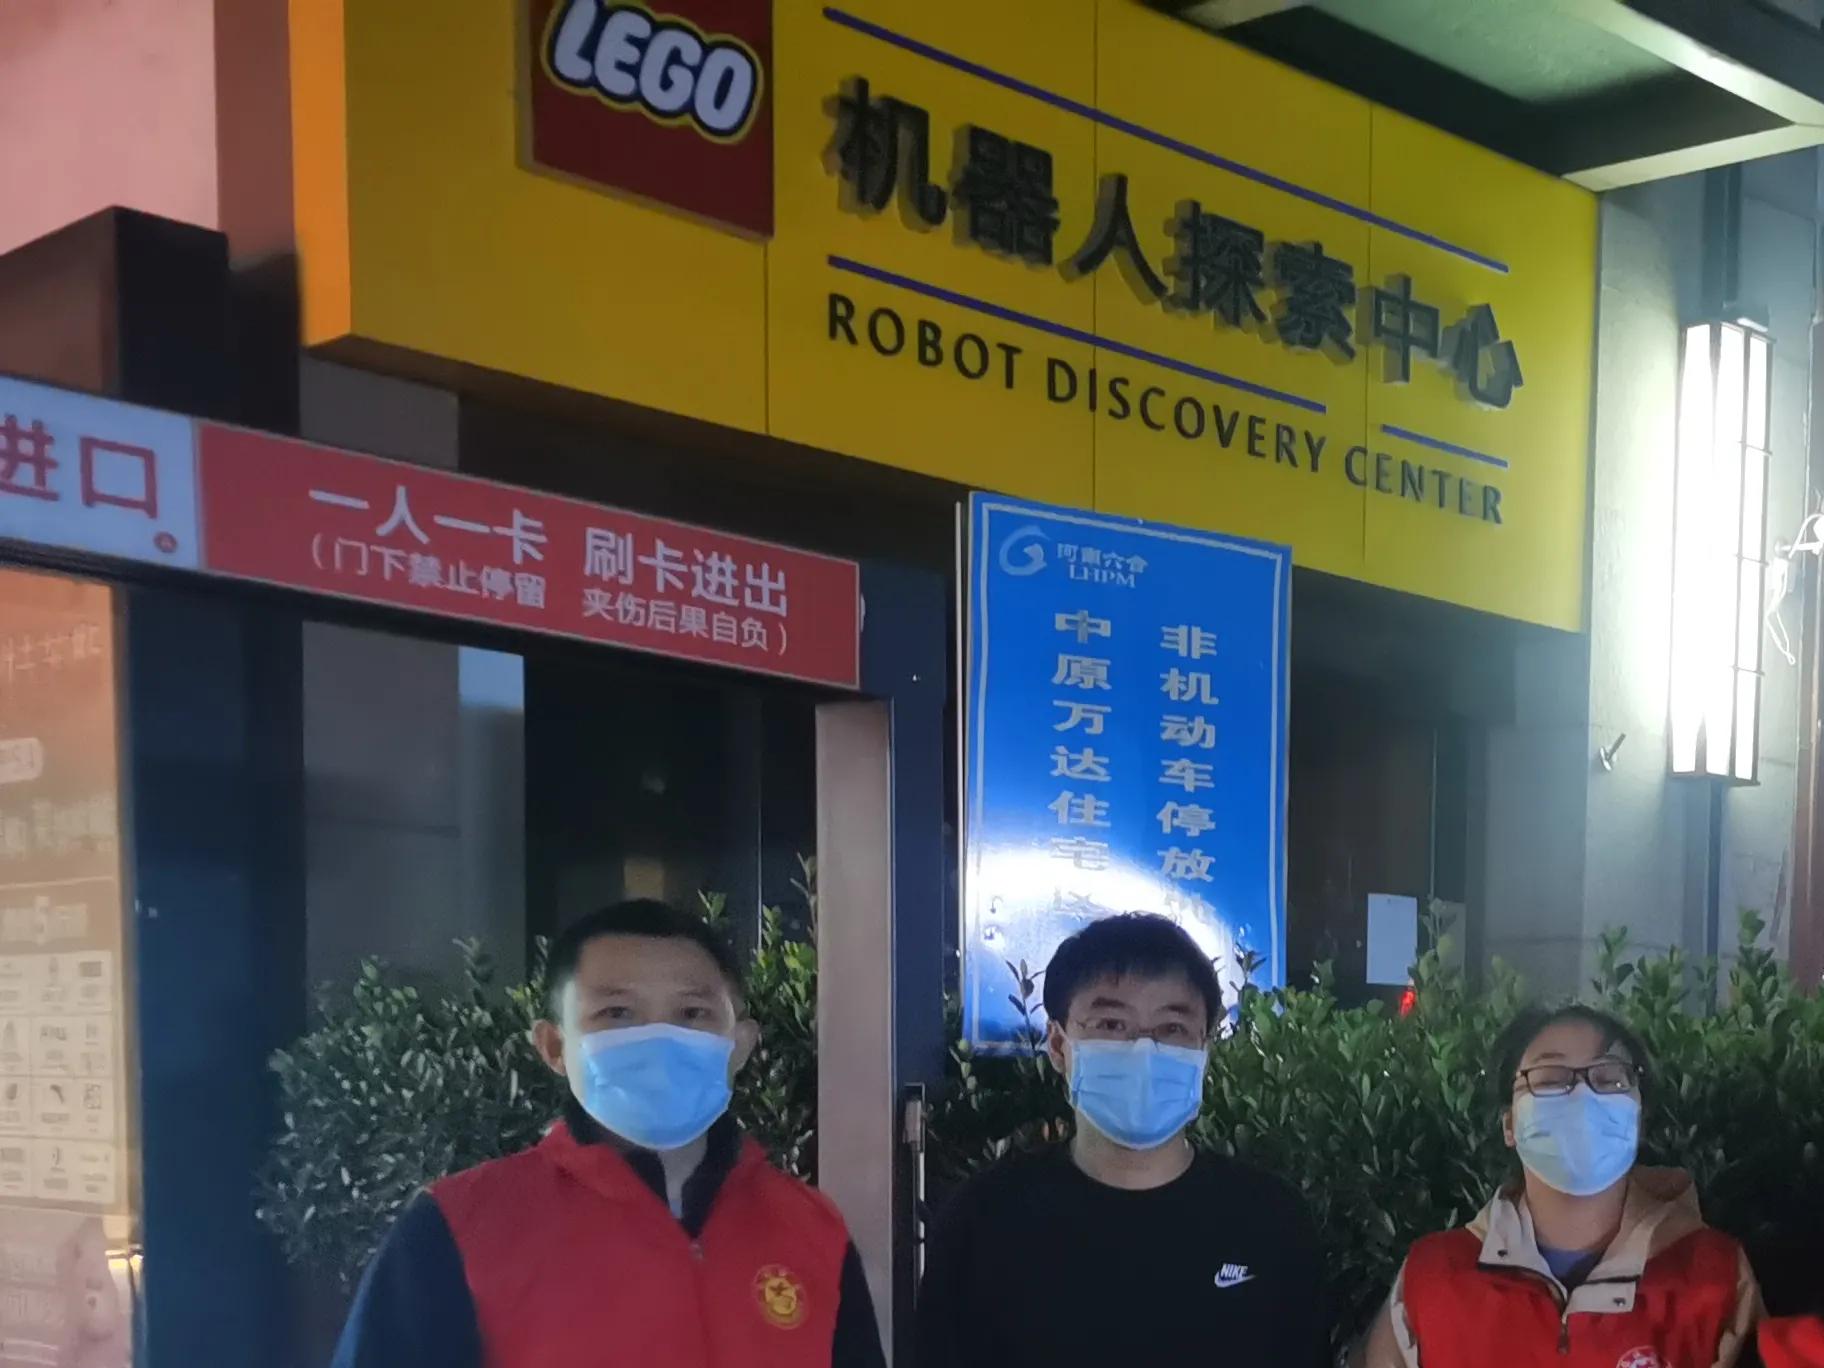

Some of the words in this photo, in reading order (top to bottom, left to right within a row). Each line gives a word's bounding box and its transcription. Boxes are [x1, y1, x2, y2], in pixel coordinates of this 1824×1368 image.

[553, 0, 754, 131] LEGO
[822, 76, 1524, 410] 机器人探索中心
[827, 292, 1023, 391] ROBOT
[1046, 357, 1327, 473] DISCOVERY
[1344, 445, 1504, 525] CENTER
[308, 485, 548, 565] 一人一卡
[583, 526, 788, 618] 刷卡进出
[1220, 1263, 1248, 1280] NIKE
